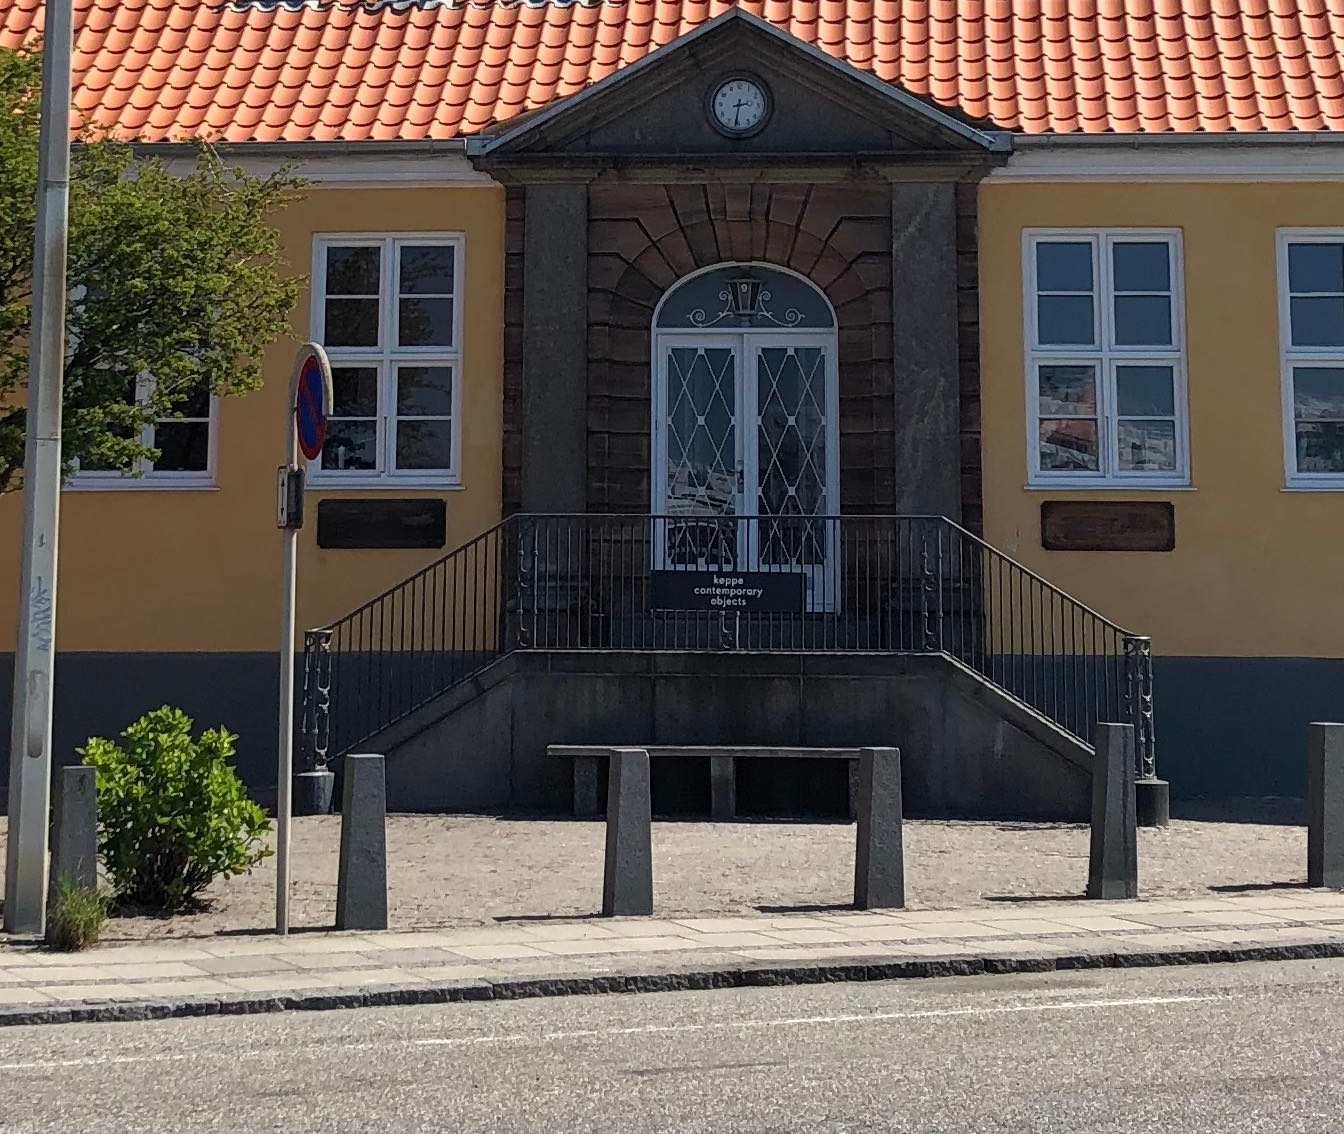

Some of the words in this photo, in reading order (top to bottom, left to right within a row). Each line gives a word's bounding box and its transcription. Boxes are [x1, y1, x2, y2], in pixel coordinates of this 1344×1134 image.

[741, 283, 748, 293] 9
[693, 586, 764, 598] contemporary
[710, 595, 747, 607] objects
